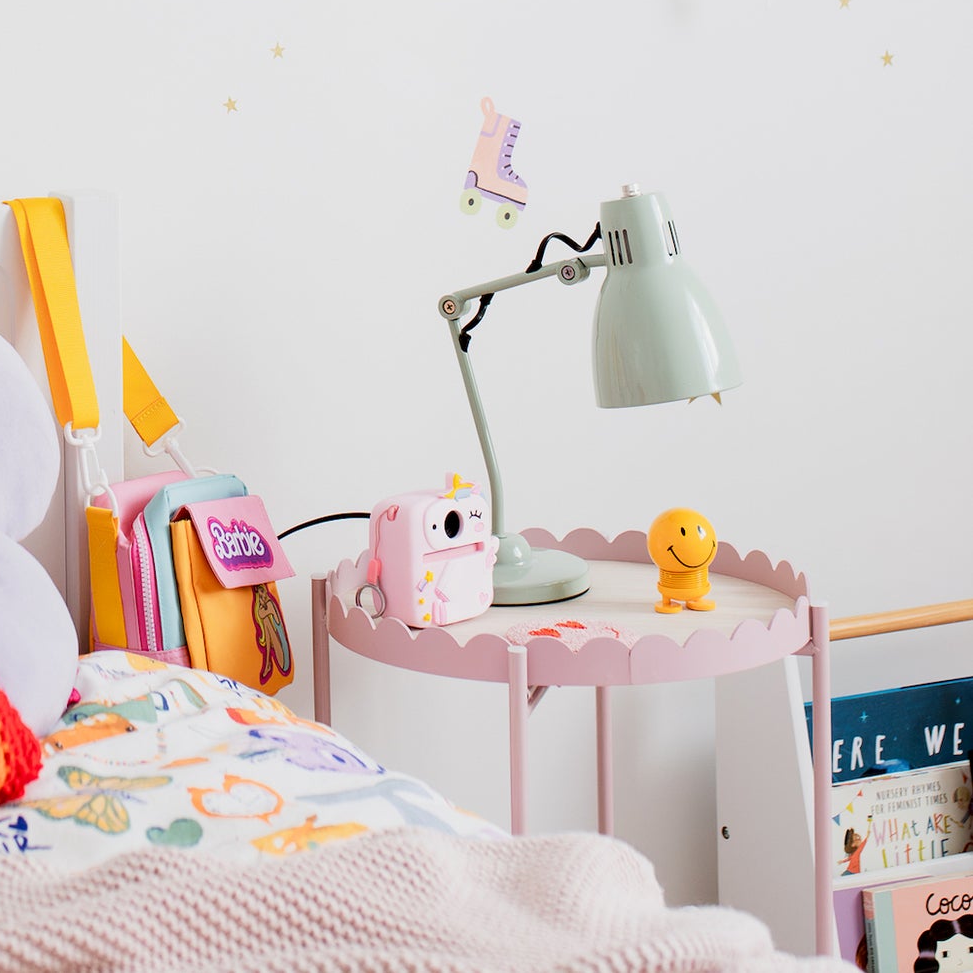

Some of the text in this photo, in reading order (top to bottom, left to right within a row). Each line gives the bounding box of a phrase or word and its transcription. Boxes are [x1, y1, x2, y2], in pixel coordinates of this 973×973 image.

[209, 520, 267, 561] Barbie
[831, 722, 965, 774] ERE WE
[925, 893, 973, 916] Coco
